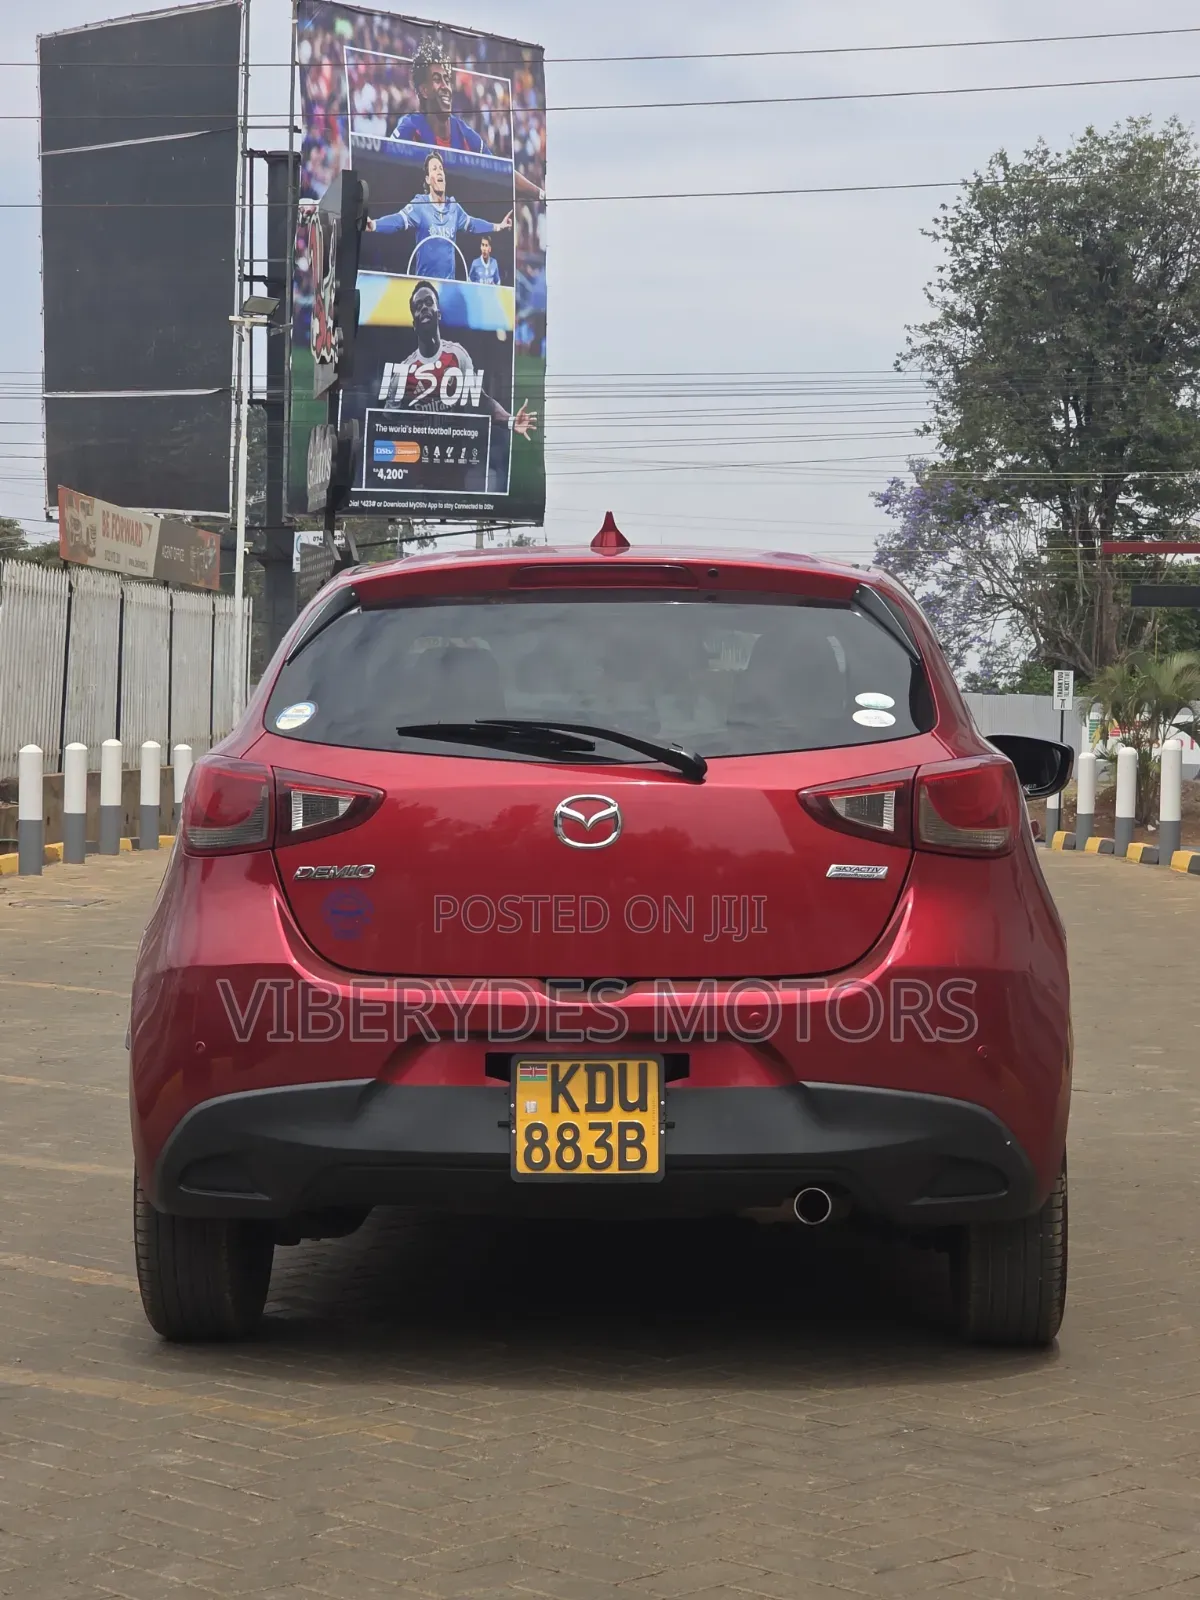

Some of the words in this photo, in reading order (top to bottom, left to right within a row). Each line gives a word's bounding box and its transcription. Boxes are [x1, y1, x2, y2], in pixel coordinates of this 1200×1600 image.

[439, 366, 485, 407] ON
[375, 423, 388, 433] The
[388, 424, 412, 434] world's
[412, 425, 427, 435] best
[427, 426, 451, 436] football
[452, 428, 478, 440] package
[383, 500, 408, 508] Download
[428, 502, 437, 511] App
[444, 503, 454, 511] stay
[454, 502, 478, 510] Connected
[111, 513, 143, 548] FORWARD
[293, 864, 376, 880] DEMIO
[835, 865, 882, 873] SKYACTIV
[551, 1062, 648, 1113] KDU
[523, 1121, 648, 1171] 883B
